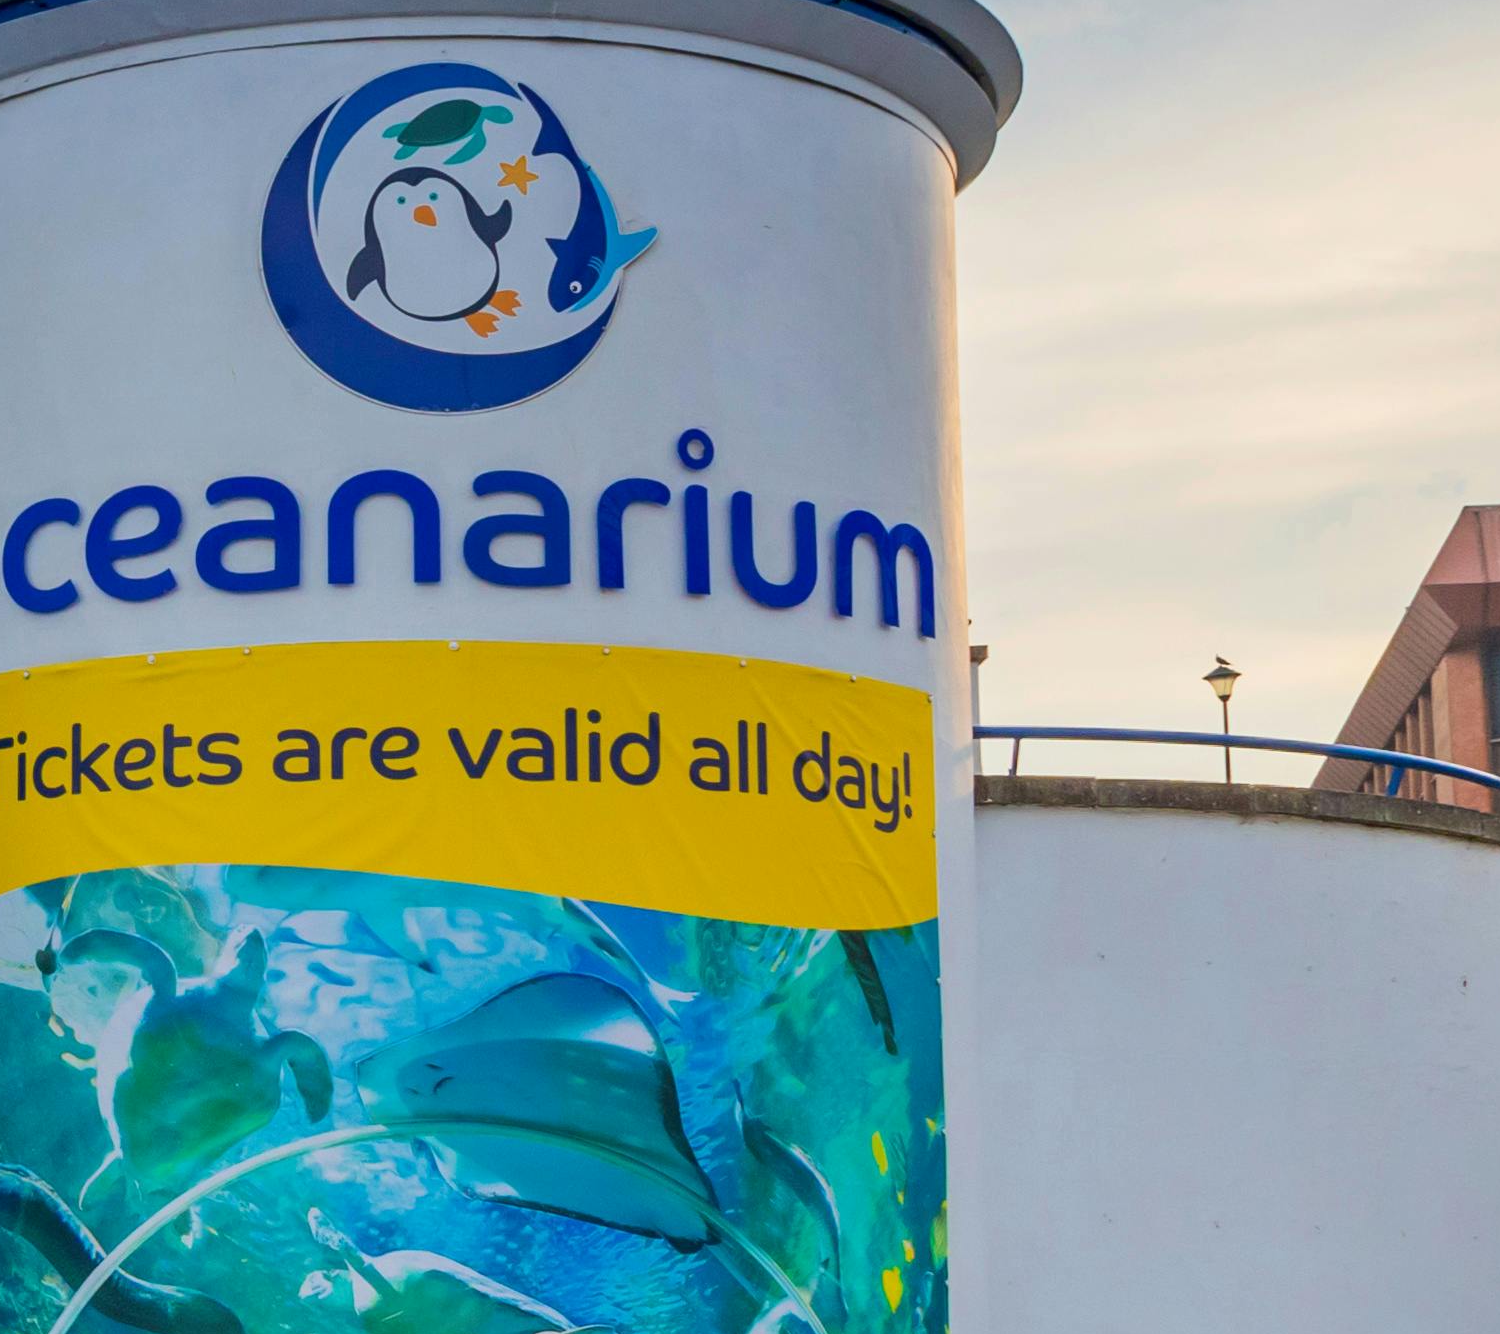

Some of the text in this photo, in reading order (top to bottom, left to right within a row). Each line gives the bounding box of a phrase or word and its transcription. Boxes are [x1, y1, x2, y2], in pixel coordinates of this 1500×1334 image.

[272, 726, 421, 783] are
[447, 707, 662, 786] valid
[688, 719, 769, 795] all
[792, 729, 913, 835] day!
